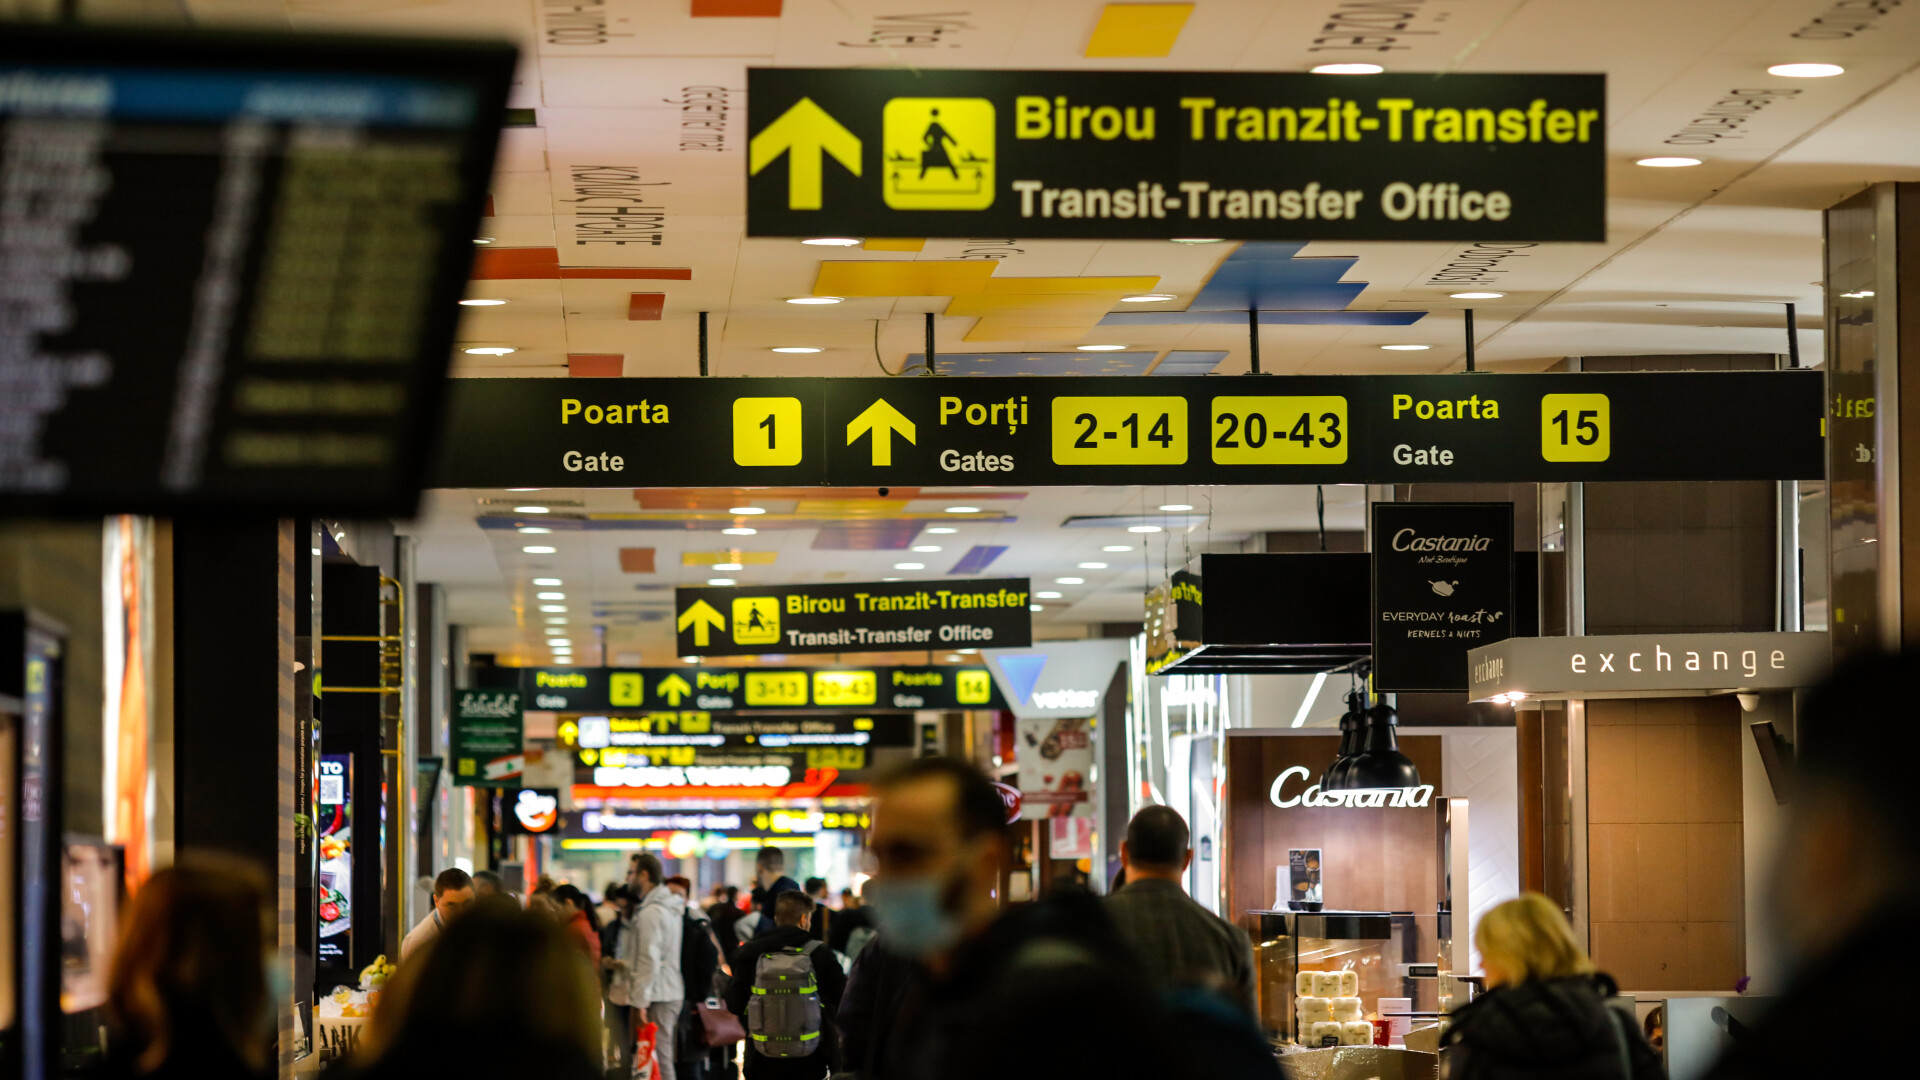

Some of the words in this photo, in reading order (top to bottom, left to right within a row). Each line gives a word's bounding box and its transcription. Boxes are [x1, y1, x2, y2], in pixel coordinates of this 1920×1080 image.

[1016, 97, 1155, 140] Birou
[1180, 98, 1598, 143] Tranzit-Transfer
[1013, 181, 1362, 219] Transit-Transfer
[1381, 182, 1511, 221] Office
[561, 398, 670, 425] Poarta
[1392, 394, 1499, 420] Poarta
[759, 413, 776, 449] 1
[1073, 412, 1174, 449] 2-14
[1215, 412, 1342, 449] 20-43
[1551, 409, 1600, 446] 15
[562, 450, 625, 472] Gate
[939, 449, 1015, 472] Gates
[1393, 444, 1454, 466] Gate
[1392, 527, 1491, 552] Castania
[786, 594, 845, 614] Birou
[855, 589, 1028, 612] Tranzit-Transfer
[1382, 611, 1445, 621] EVERYDAY
[1448, 608, 1488, 624] roast
[787, 626, 932, 646] Transit-Transfer
[939, 625, 993, 642] Office
[1407, 629, 1446, 638] KERNELS
[1456, 629, 1481, 638] NUTS
[1474, 655, 1504, 685] exchange
[1571, 645, 1785, 678] exchange
[536, 671, 588, 688] Poarta
[756, 680, 799, 698] 3-13
[818, 680, 871, 697] 20-43
[893, 671, 943, 686] Poarta
[964, 680, 983, 696] 14
[536, 694, 568, 708] Gate
[622, 682, 633, 698] 2
[893, 693, 924, 708] Gate
[697, 694, 734, 709] Gates
[1270, 765, 1434, 808] Castania
